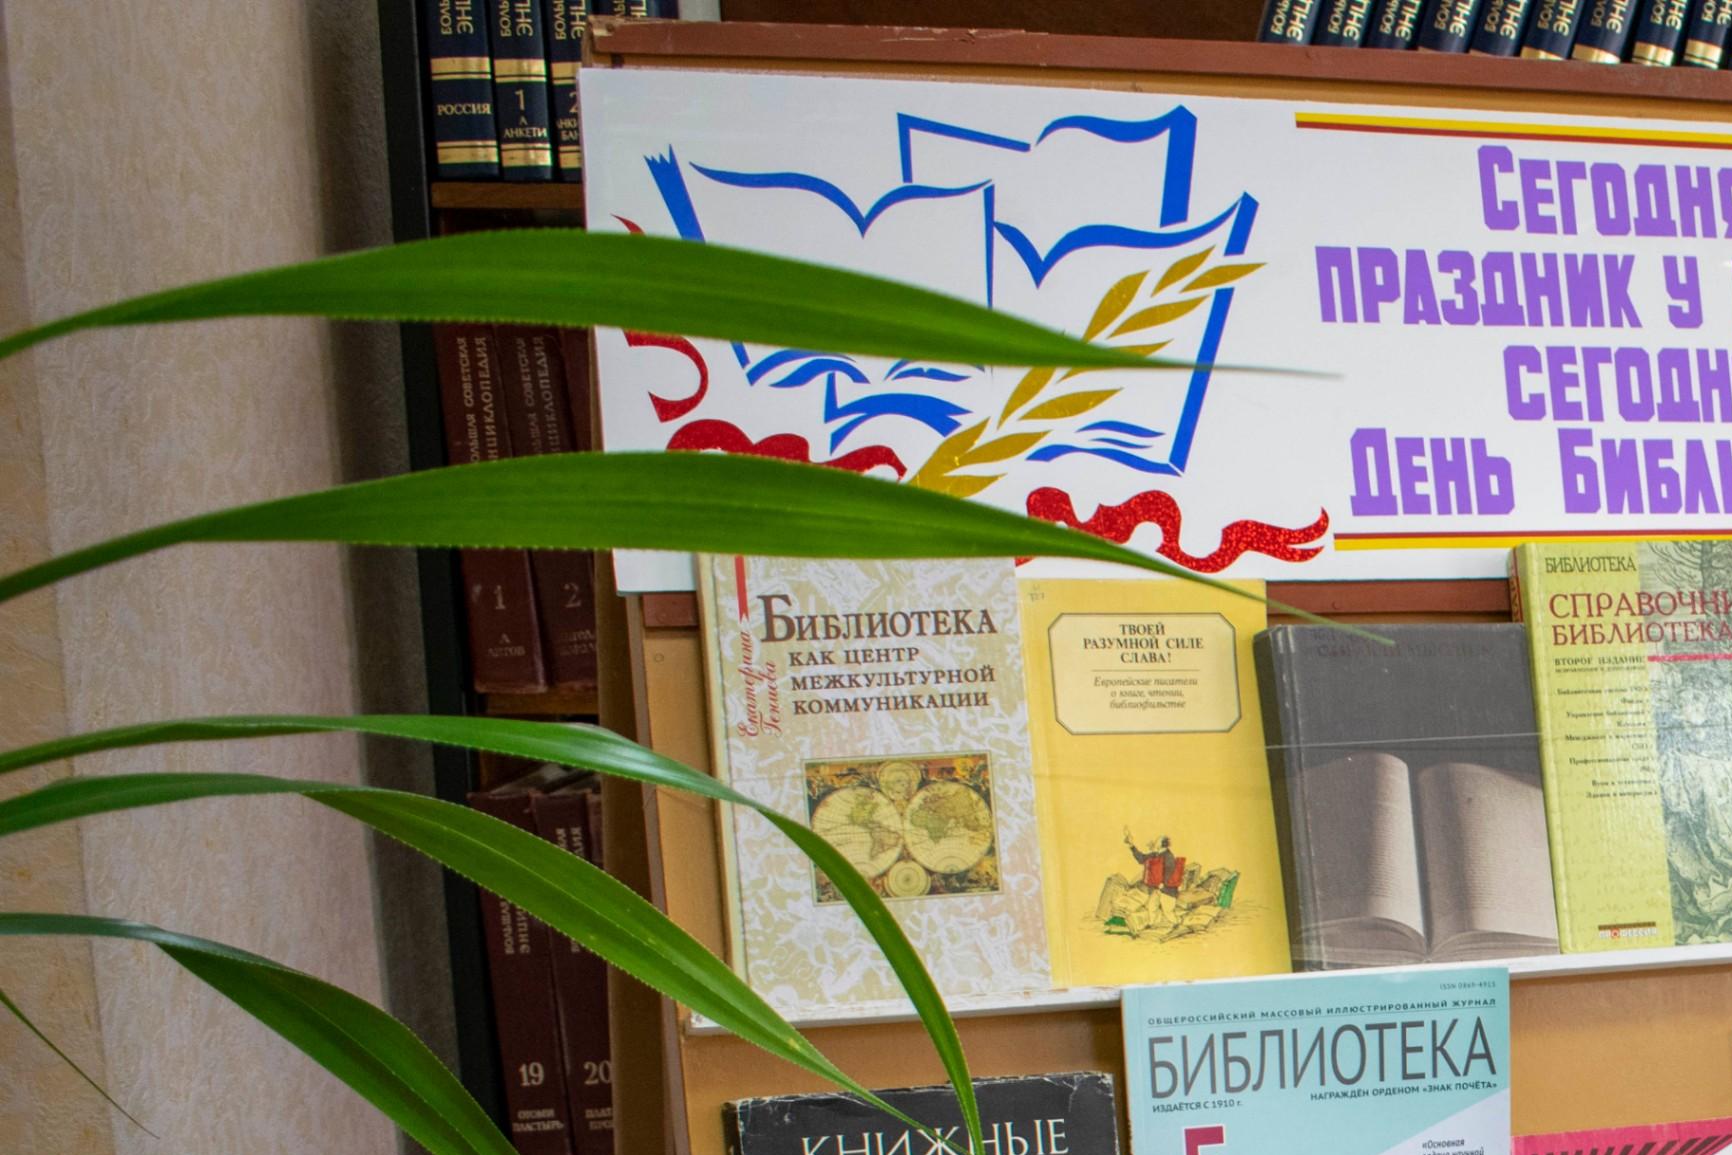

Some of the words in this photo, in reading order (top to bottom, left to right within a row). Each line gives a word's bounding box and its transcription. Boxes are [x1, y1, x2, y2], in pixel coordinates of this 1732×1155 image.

[437, 103, 492, 115] РОССИЯ
[515, 89, 526, 111] 1
[1314, 245, 1643, 330] ПРАЗДНИК
[1663, 255, 1704, 330] У
[457, 337, 475, 408] СОВЕТСКАЯ
[474, 336, 498, 461] НЦИКЛОПЕДИЯ
[1348, 426, 1516, 517] ДЕНЬ
[1545, 556, 1637, 574] БИБЛИОТЕКА
[757, 594, 998, 643] БИБЛИОТЕКА
[1119, 622, 1165, 636] ТВОЕЙ
[1083, 637, 1160, 650] РАЗУМНОЙ
[1166, 637, 1204, 649] СИЛЕ
[789, 647, 835, 666] КАК
[844, 646, 919, 668] ЦЕНТР
[1120, 652, 1172, 664] СЛАВА!
[738, 630, 757, 737] Екатерина
[791, 665, 996, 691] МЕЖКУЛЬТУРНОЙ
[1094, 676, 1152, 688] Европейские
[1154, 677, 1198, 687] писатели
[793, 691, 990, 716] КОММУНИКАЦИИ
[1148, 1010, 1257, 1025] ОБЩЕРОССИЙСКИЙ
[1260, 1005, 1322, 1019] МАССОВЫЙ
[1326, 1000, 1449, 1015] ИЛЛЮСТРИРОВАННЫЙ
[1452, 997, 1497, 1008] ЖУРНАЛ
[1148, 1016, 1497, 1099] БИБЛИОТЕКА
[519, 1062, 545, 1087] 19
[1310, 1088, 1370, 1101] НАГРАЖДЁН
[1372, 1084, 1420, 1097] ОРДЕНОМ
[1422, 1082, 1453, 1094] «ЗНАК
[1152, 1100, 1202, 1113] ИЗДАЁТСЯ
[1211, 1099, 1236, 1110] 1910
